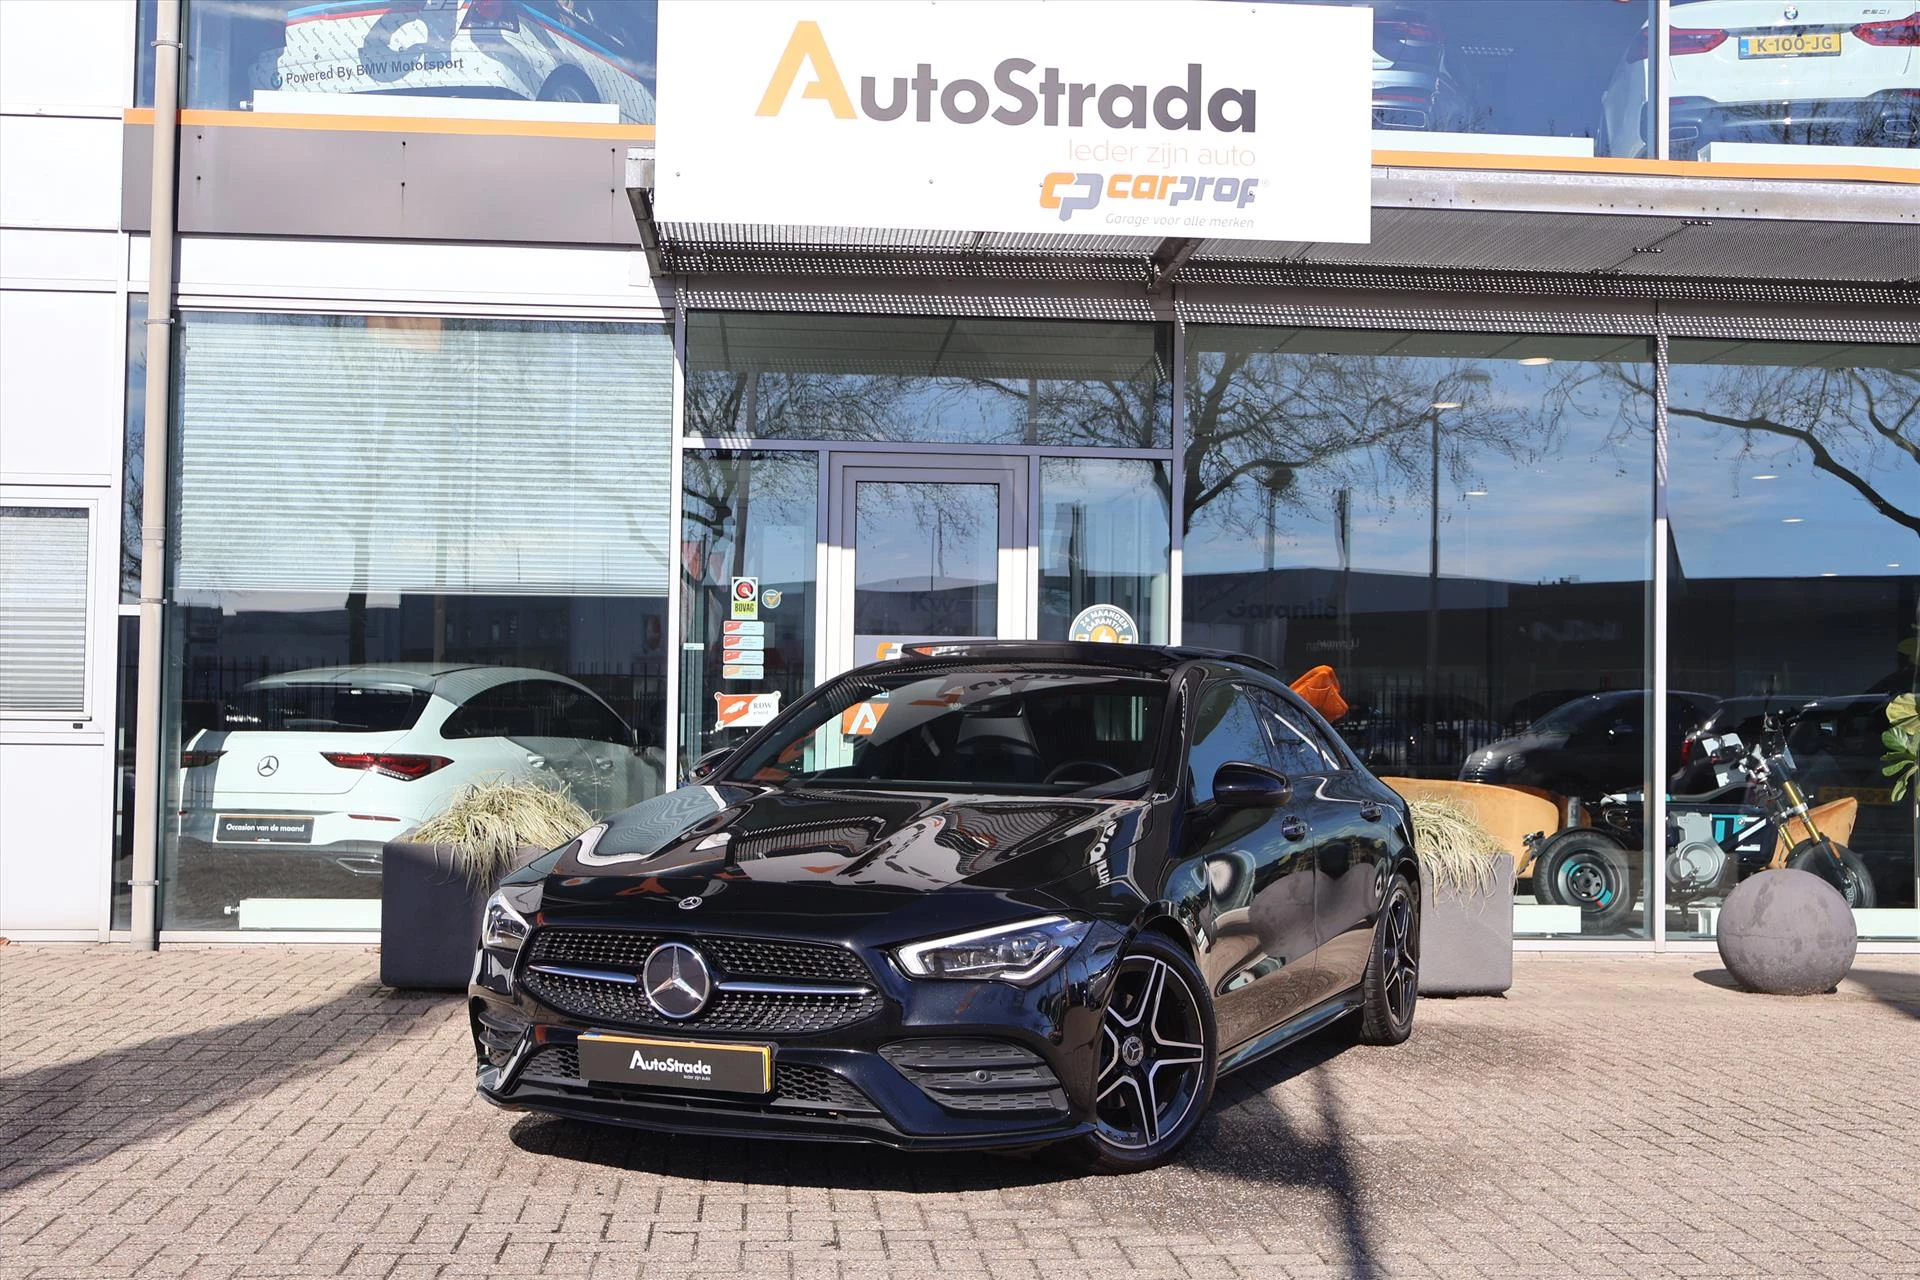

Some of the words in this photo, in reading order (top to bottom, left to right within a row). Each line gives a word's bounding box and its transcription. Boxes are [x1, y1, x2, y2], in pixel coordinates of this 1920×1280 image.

[1757, 37, 1833, 52] K-100-JG
[286, 67, 334, 84] Powered
[337, 66, 352, 80] By
[356, 62, 388, 76] BMW
[391, 57, 464, 73] Motorsport
[754, 20, 1257, 133] AutoStrada
[1068, 139, 1139, 162] Ieder
[1146, 142, 1188, 169] zijn
[1198, 145, 1256, 167] auto
[1106, 174, 1259, 209] carprof
[1105, 212, 1150, 228] Garage
[1153, 217, 1179, 227] voor
[1183, 215, 1206, 227] alle
[1208, 217, 1254, 229] merken
[734, 602, 755, 613] BOVAG
[1080, 616, 1090, 628] 24
[1090, 610, 1129, 630] MAANDEN
[1085, 617, 1123, 633] GARANTIE
[753, 702, 773, 710] RDW
[226, 823, 255, 832] Occasion
[270, 823, 280, 832] de
[280, 824, 305, 833] maand
[629, 1049, 712, 1075] AutoStrada
